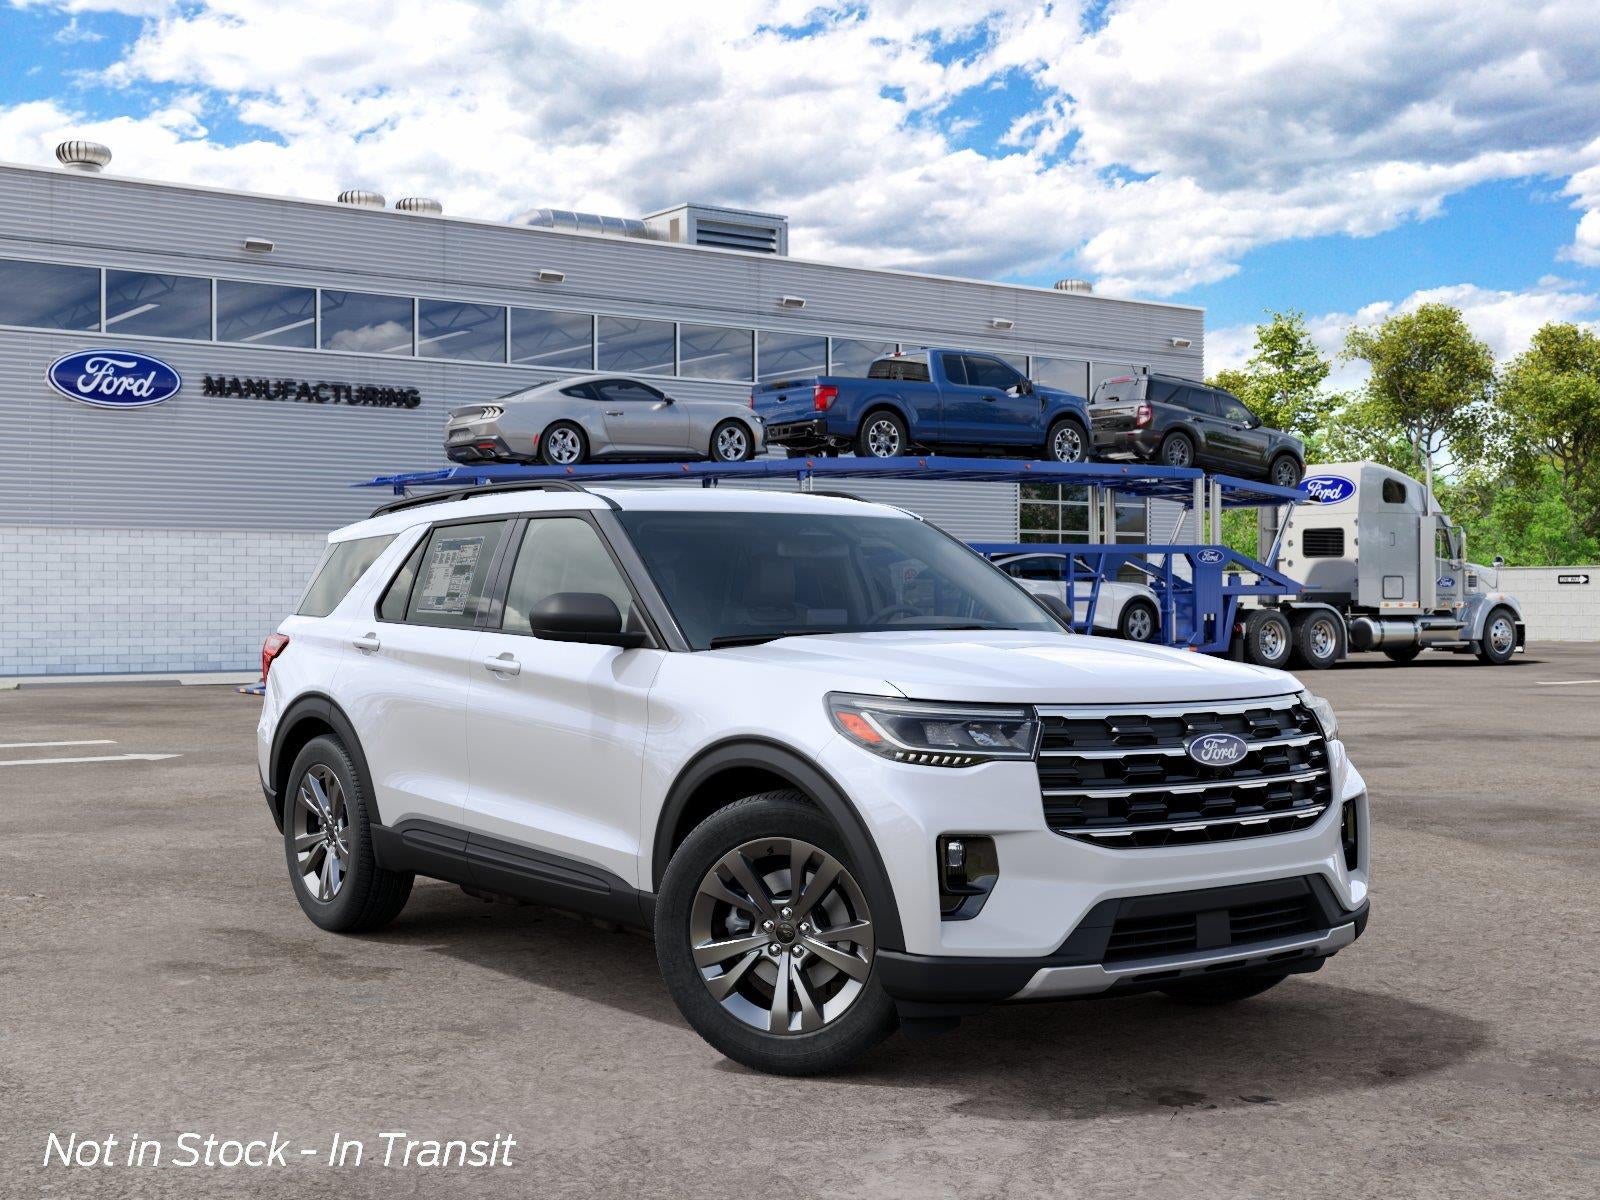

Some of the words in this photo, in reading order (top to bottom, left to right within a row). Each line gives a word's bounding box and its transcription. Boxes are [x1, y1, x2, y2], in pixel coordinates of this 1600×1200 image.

[76, 356, 157, 398] Ford
[203, 374, 422, 408] MANUFACTURING
[1201, 551, 1220, 561] Ford
[1201, 738, 1238, 761] Ford
